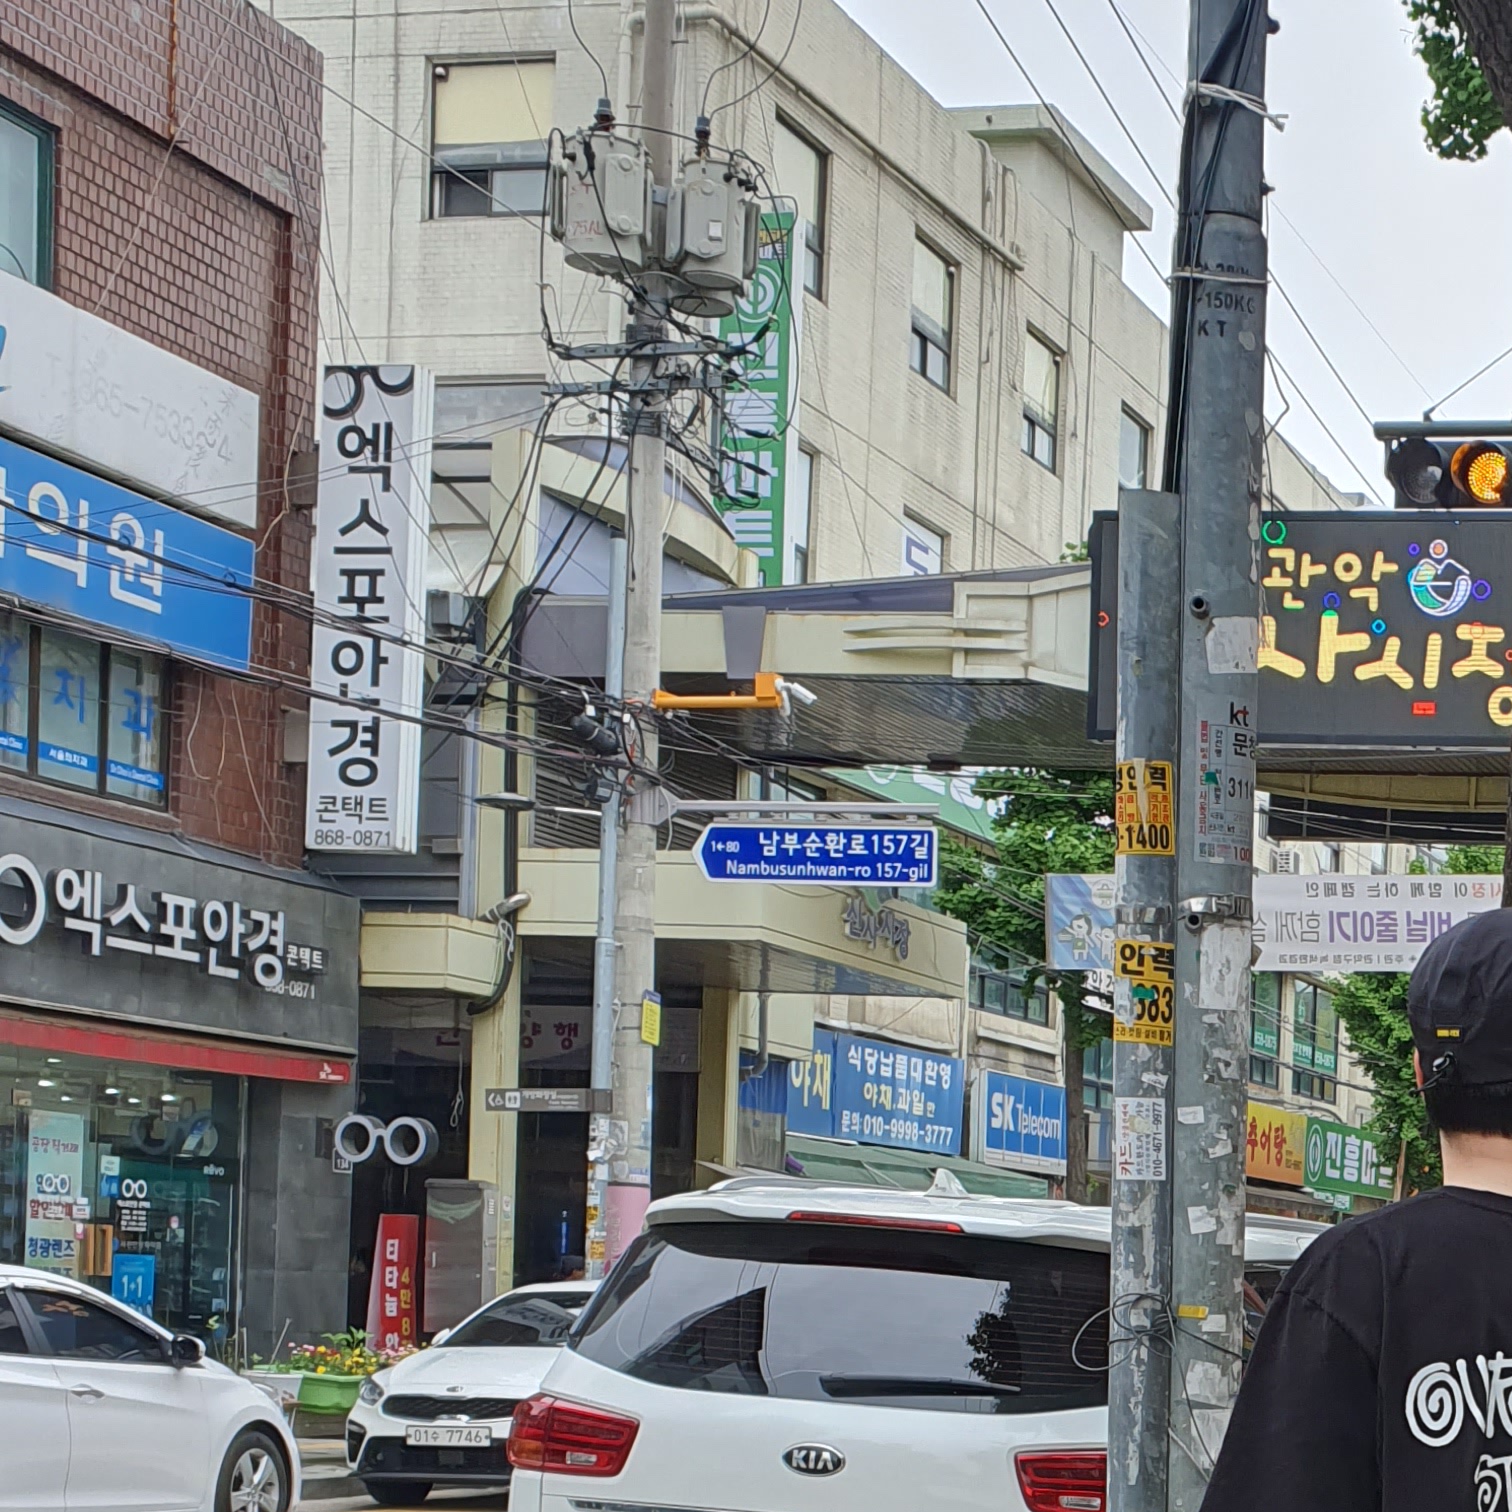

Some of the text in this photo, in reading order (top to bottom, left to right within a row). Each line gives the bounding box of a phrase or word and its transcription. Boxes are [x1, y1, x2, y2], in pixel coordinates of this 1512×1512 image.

[1262, 547, 1399, 612] 관악
[1229, 701, 1250, 727] kt
[314, 796, 390, 825] 콘택트
[314, 828, 392, 847] 868-0871
[758, 831, 930, 860] 남부순환로157길
[726, 860, 929, 882] Nambusunhwan-ro 157-gil
[55, 868, 286, 987] 엑스포안경
[286, 944, 324, 969] 콘택트
[790, 1052, 832, 1111] 야채
[847, 1044, 953, 1090] 식당납품대환영
[990, 1091, 1061, 1141] SK Telecom
[1247, 1115, 1287, 1167] 추어탕
[121, 1275, 144, 1299] 1+1
[445, 1429, 483, 1444] 7746
[790, 1449, 835, 1471] KIA
